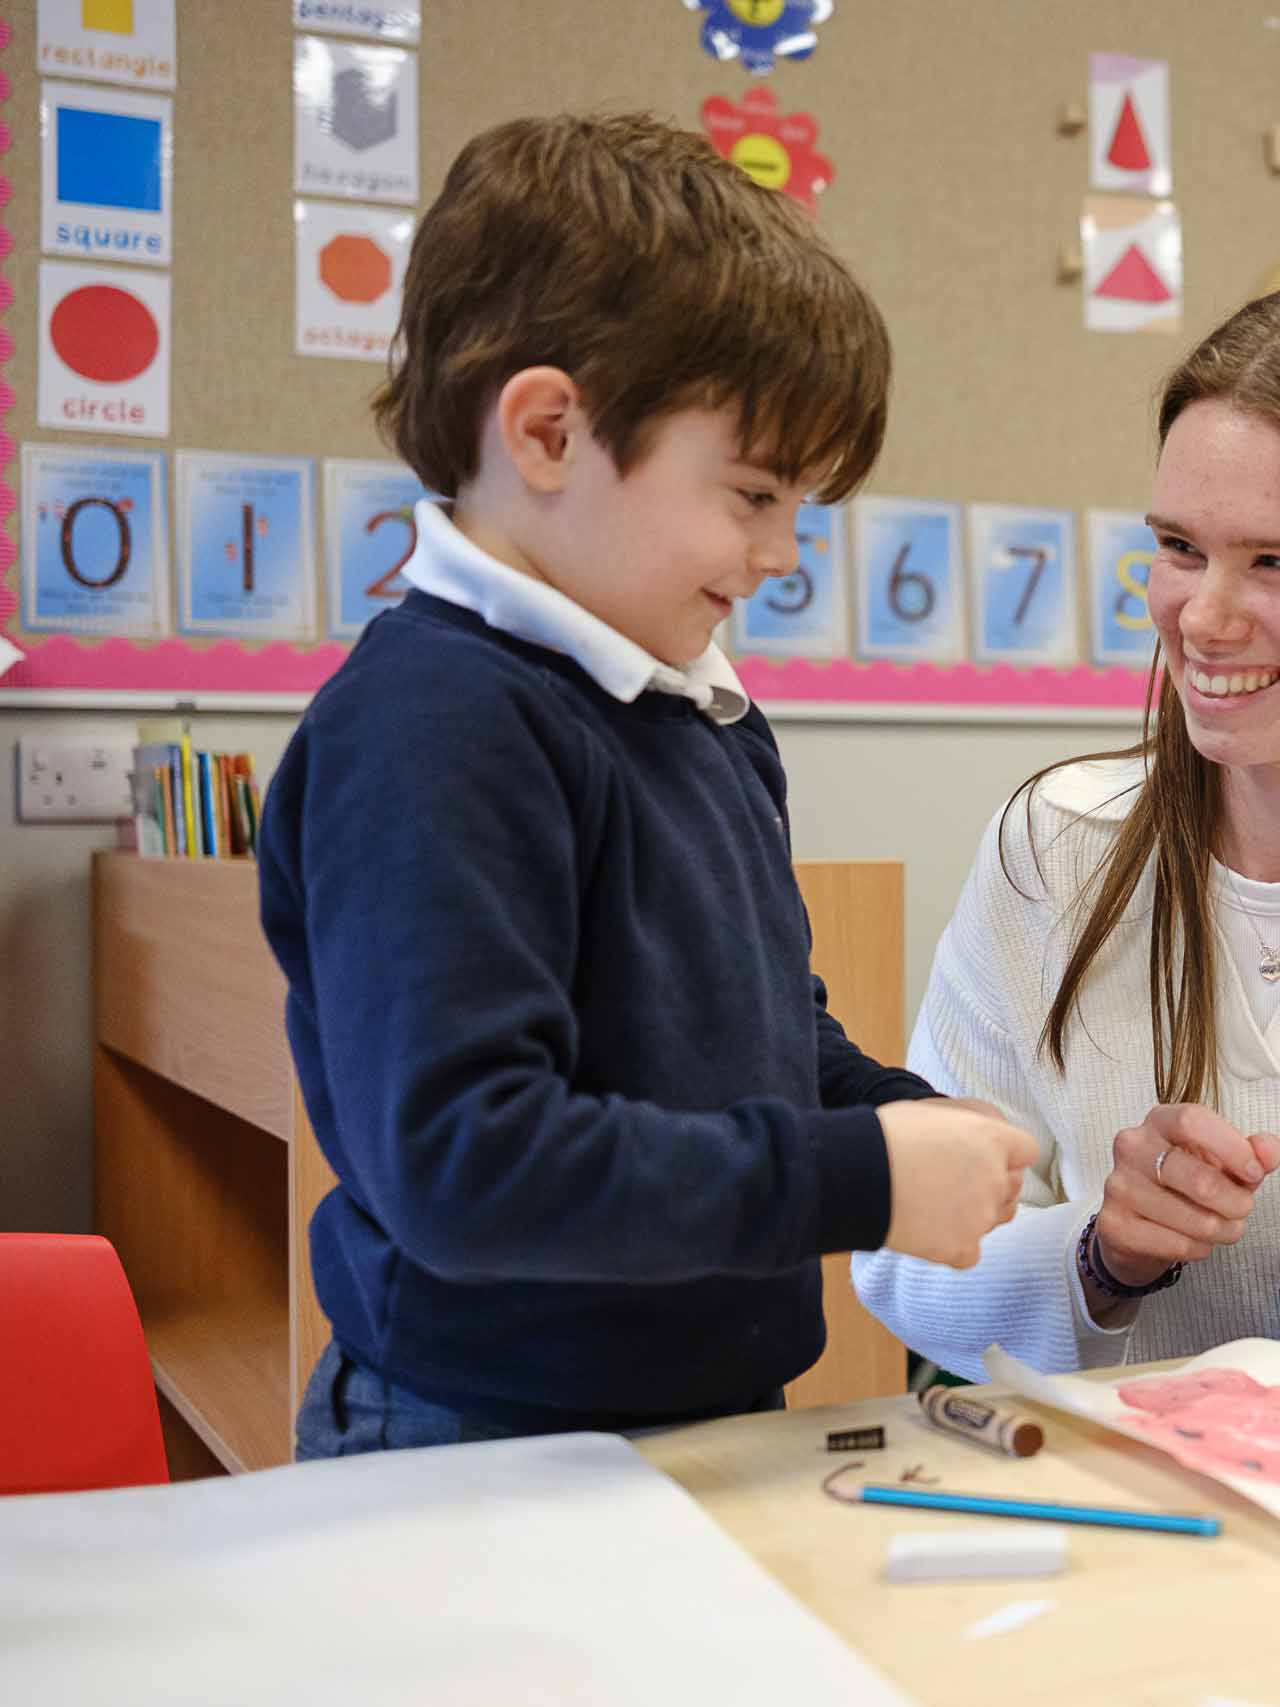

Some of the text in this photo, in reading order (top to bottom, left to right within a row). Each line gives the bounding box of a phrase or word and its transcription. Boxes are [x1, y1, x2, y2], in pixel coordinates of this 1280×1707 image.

[42, 46, 170, 78] rectangle
[57, 223, 161, 256] square
[304, 325, 393, 352] octago
[63, 394, 144, 424] circle
[61, 497, 132, 589] 0
[364, 504, 419, 599] 2
[887, 541, 935, 623] 6
[1007, 546, 1048, 625] 7
